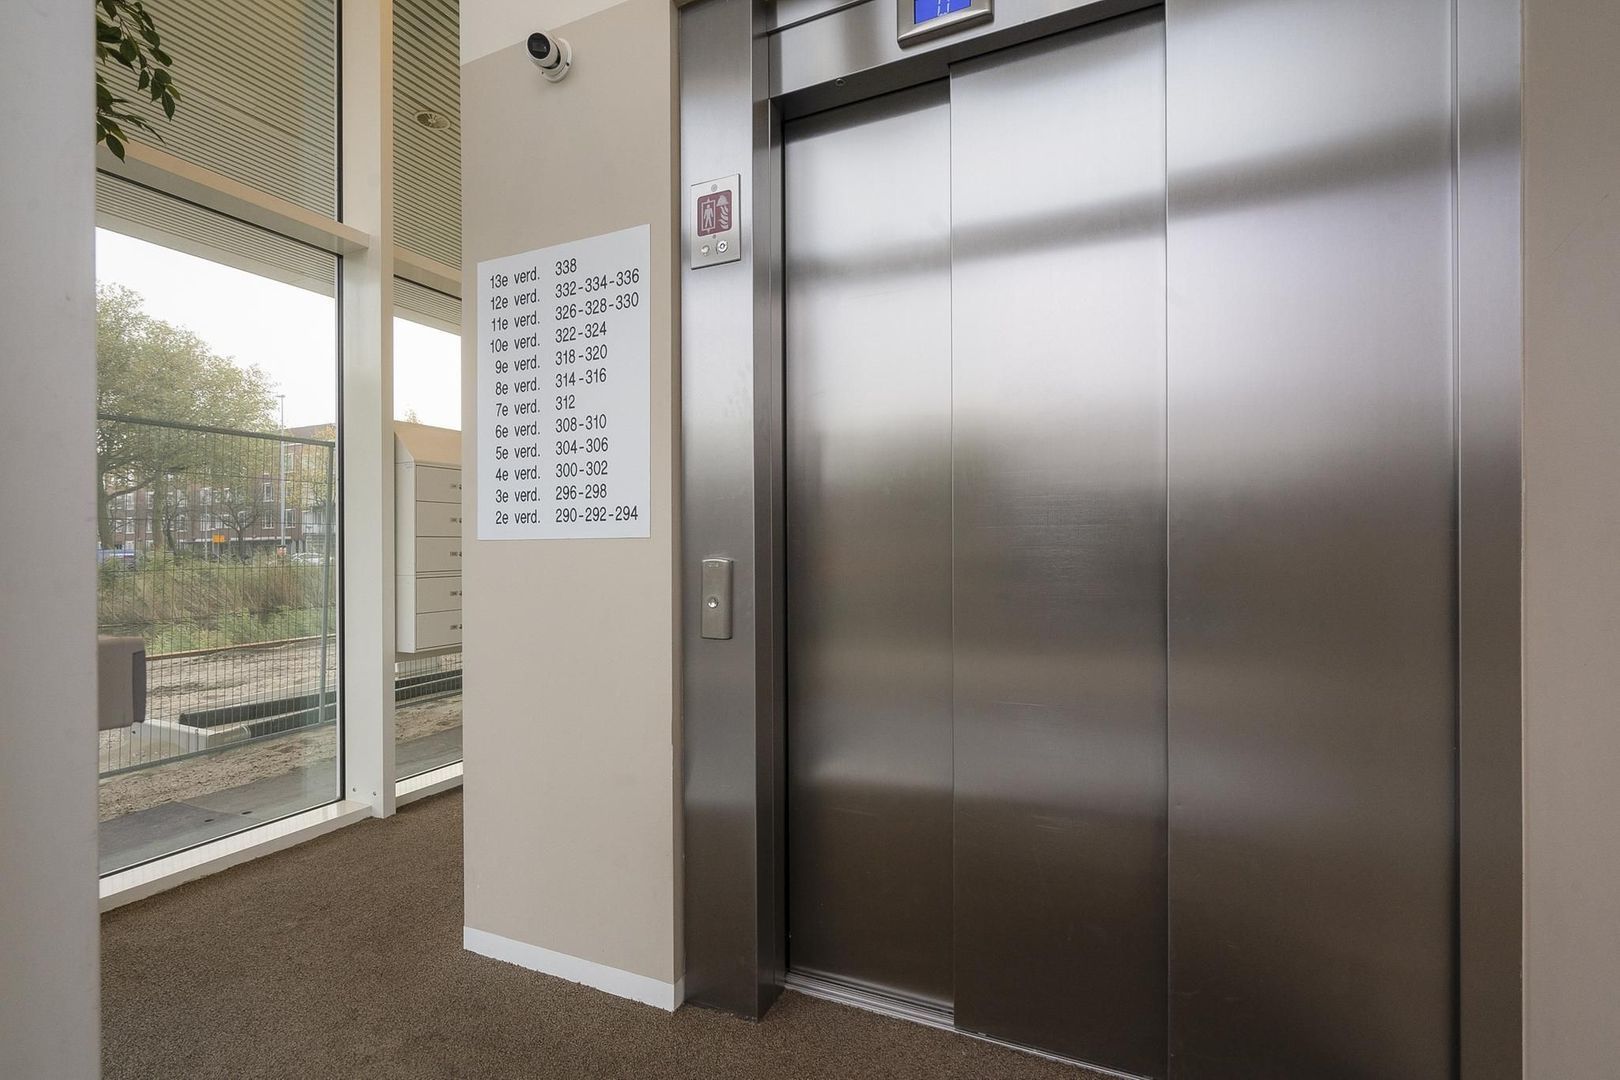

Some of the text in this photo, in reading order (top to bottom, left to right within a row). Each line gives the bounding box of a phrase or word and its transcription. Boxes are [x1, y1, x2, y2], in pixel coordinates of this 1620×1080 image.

[490, 258, 577, 289] 13e verd. 338
[491, 268, 639, 311] 12e verd. 332-334-336
[492, 292, 639, 332] 11e verd. 326-328-330
[490, 321, 607, 353] 10e verd. 322-324
[495, 344, 607, 376] 9e verd. 318-320
[495, 368, 606, 396] 8e verd. 314-316
[496, 394, 575, 416] 7e verd. 312
[495, 414, 606, 440] 6e verd. 308-310
[496, 437, 608, 460] 5e verd. 304-306
[495, 460, 608, 481] 4e verd. 300-302
[496, 483, 607, 503] 3e verd. 296-298
[496, 505, 638, 524] 2e verd. 290-292-294
